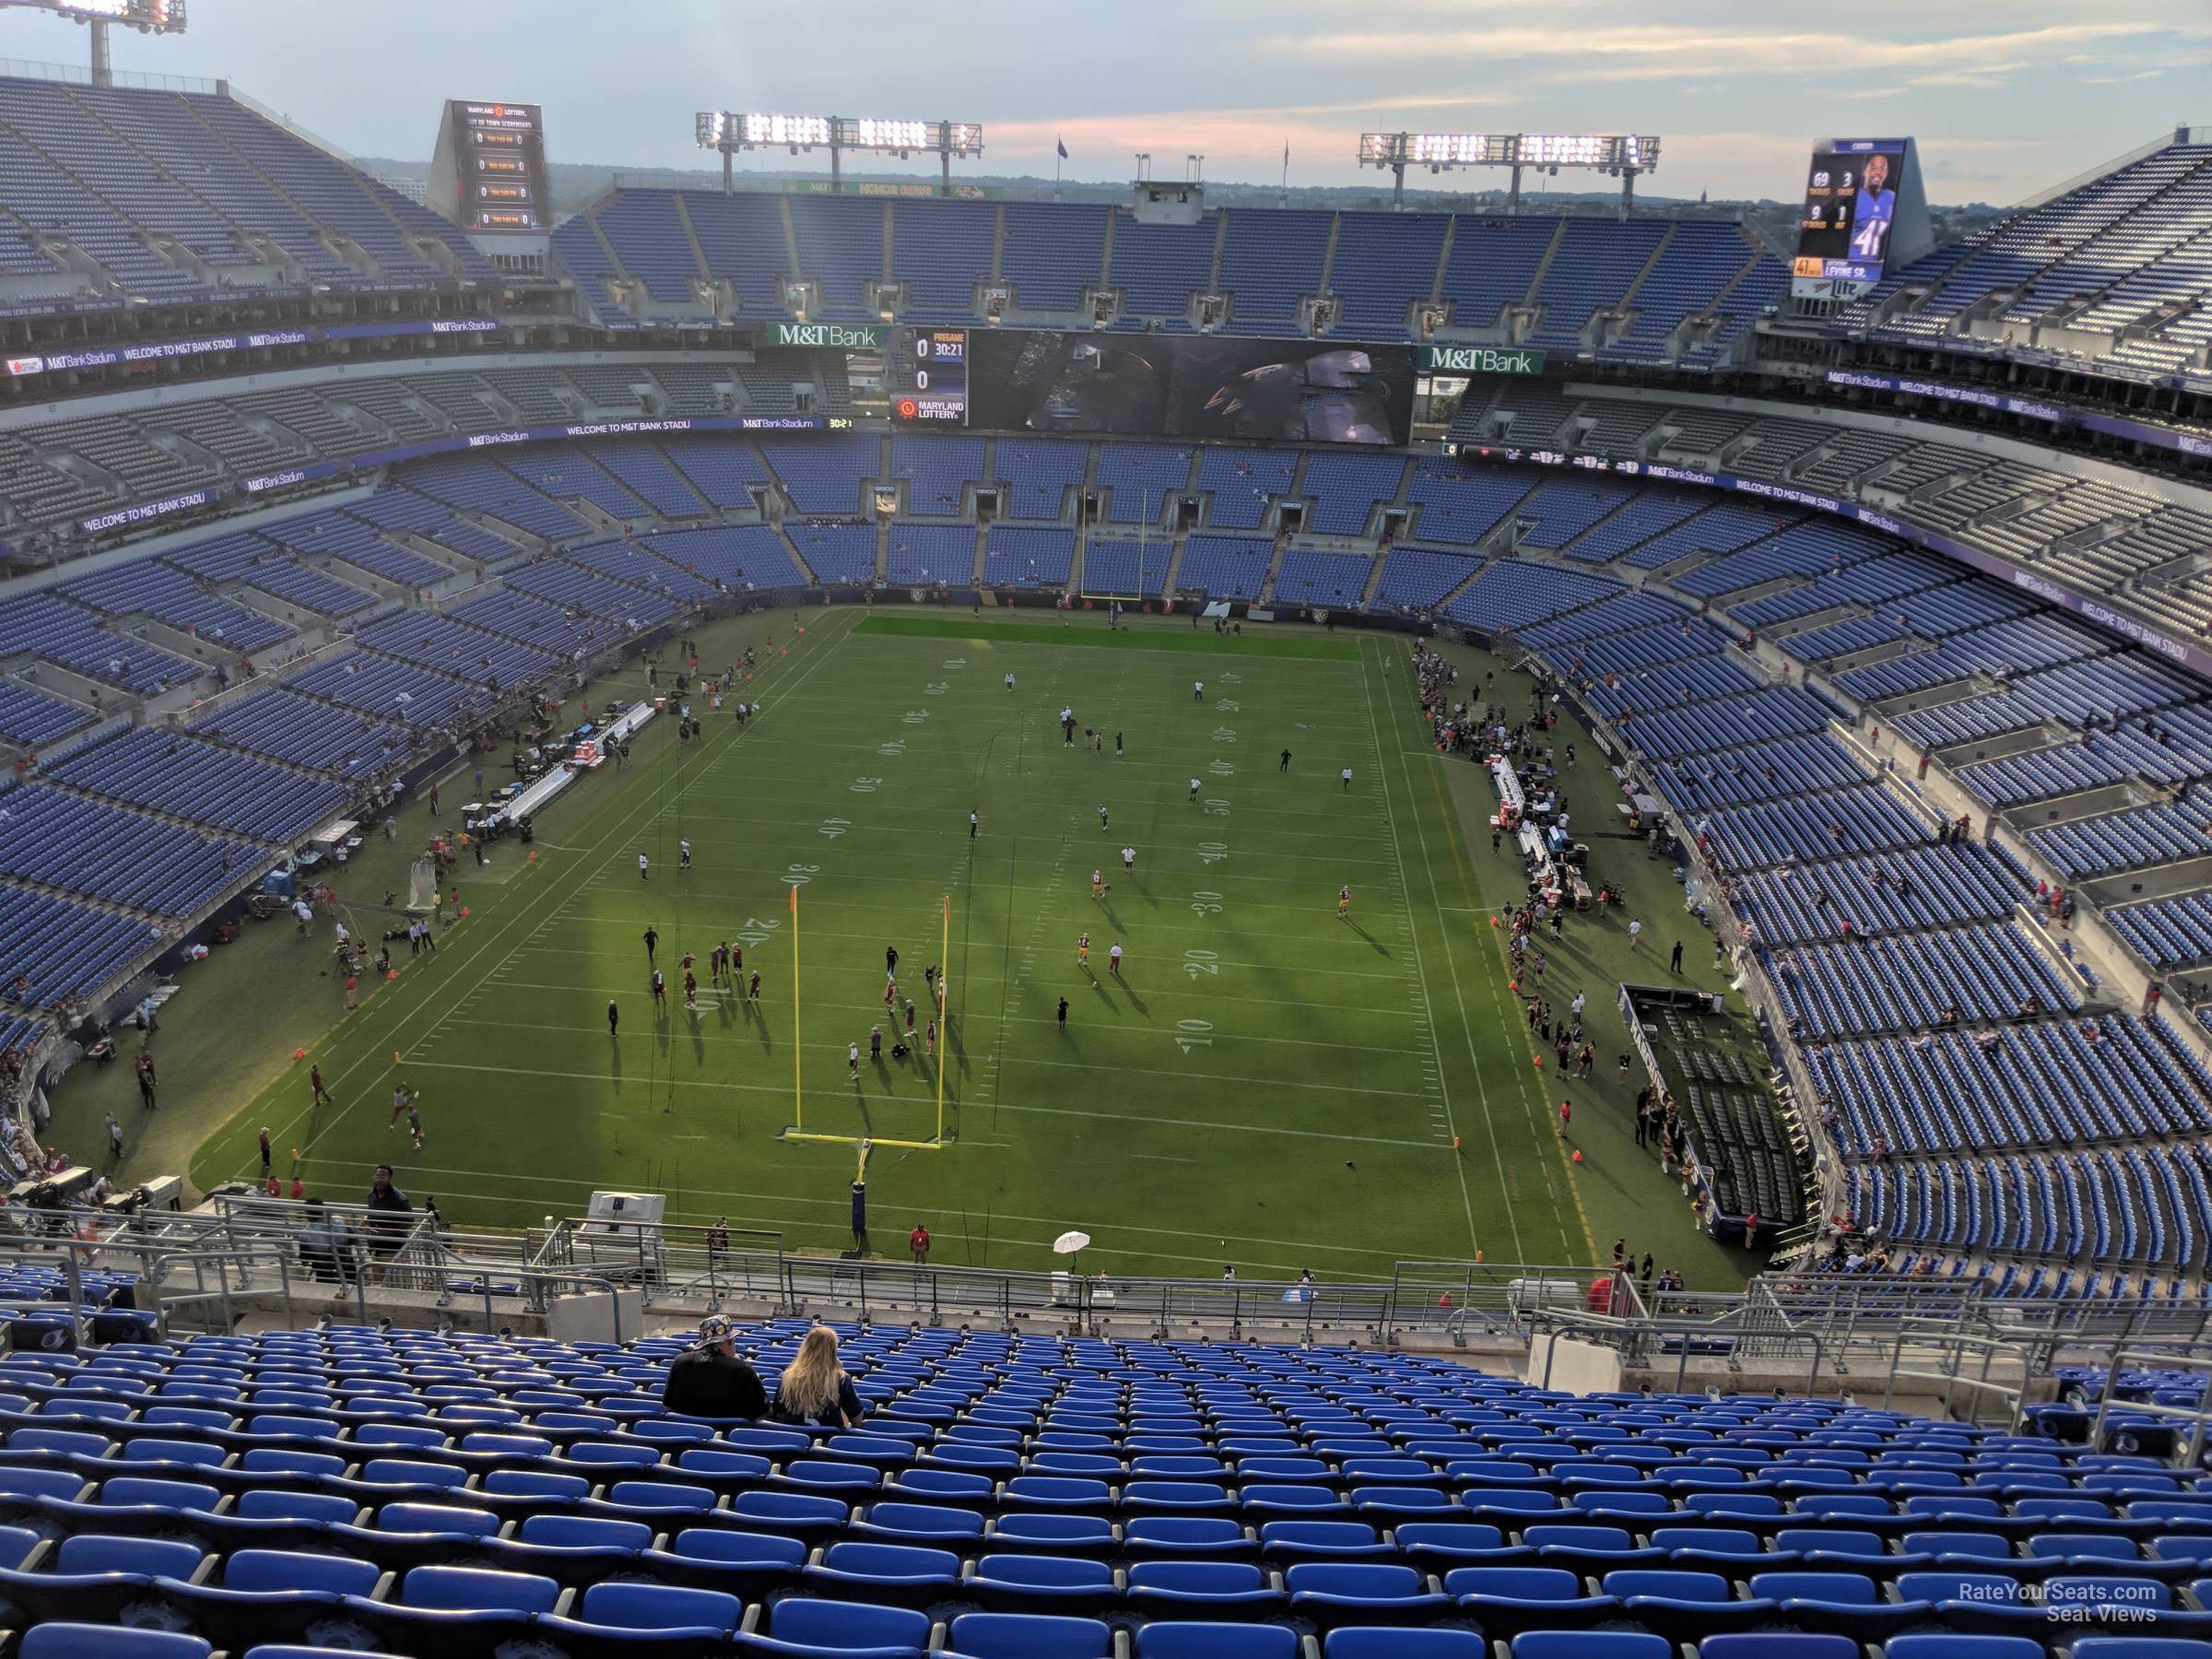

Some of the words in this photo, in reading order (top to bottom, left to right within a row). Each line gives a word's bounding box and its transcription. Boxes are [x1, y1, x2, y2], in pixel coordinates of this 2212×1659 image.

[477, 133, 482, 143] 0
[517, 135, 522, 144] 0
[480, 160, 484, 170] 0
[519, 162, 524, 171] 0
[1843, 172, 1853, 187] 3
[482, 187, 487, 196] 0
[521, 188, 526, 197] 0
[483, 214, 488, 224] 0
[523, 215, 528, 224] 0
[1839, 206, 1846, 221] 1
[1853, 220, 1888, 255] 41
[1825, 267, 1853, 277] LEVINE
[1830, 280, 1856, 298] Lite
[433, 322, 451, 332] M&T
[452, 321, 468, 331] Bank
[468, 321, 495, 330] Stadium
[779, 324, 829, 345] M&T
[830, 326, 877, 347] Bank
[250, 335, 265, 347] M&T
[265, 334, 280, 345] Bank
[281, 333, 305, 343] Stadium
[934, 333, 965, 342] PREGAME
[124, 346, 163, 360] WELCOME
[163, 345, 175, 355] TO
[192, 342, 212, 353] BANK
[918, 339, 928, 358] 0
[935, 343, 962, 357] 30:21
[47, 357, 67, 369] M&T
[67, 354, 87, 368] Bank
[87, 351, 117, 365] Stadium
[1430, 347, 1483, 369] M&T
[1483, 350, 1532, 372] Bank
[918, 371, 928, 390] 0
[919, 401, 964, 412] MARYLAND
[568, 424, 607, 435] WELCOME
[609, 424, 620, 432] TO
[621, 423, 638, 431] M&T
[640, 421, 661, 430] BANK
[743, 419, 763, 428] M&T
[763, 419, 782, 428] Bank
[782, 419, 813, 428] Stadium
[830, 418, 852, 428] 30:21
[470, 436, 485, 447] M&T
[486, 434, 500, 444] Bank
[500, 431, 529, 442] Stadium
[248, 478, 265, 491] M&T
[265, 475, 279, 488] Bank
[279, 471, 305, 485] Stadium
[1648, 465, 1668, 476] M&T
[1668, 467, 1686, 479] Bank
[1686, 470, 1714, 484] Stadium
[1736, 479, 1772, 495] WELCOME
[1773, 487, 1783, 497] TO
[1800, 493, 1818, 505] BANK
[84, 512, 127, 531] WELCOME
[128, 509, 139, 521] TO
[141, 504, 157, 518] M&T
[159, 499, 180, 514] BANK
[2082, 601, 2115, 625] WELCOME
[2115, 616, 2127, 630] TO
[2142, 628, 2163, 648] BANK
[902, 708, 930, 724] 30
[1213, 729, 1236, 742] 30
[877, 739, 907, 756] 40
[1209, 762, 1234, 776] 40
[849, 776, 883, 793] 50
[1203, 799, 1231, 817] 50
[818, 817, 853, 835] 40
[1197, 842, 1228, 860] 40
[780, 862, 820, 884] 30
[1191, 891, 1224, 913] 30
[736, 918, 781, 943] 20
[1182, 949, 1219, 975] 20
[683, 988, 731, 1011] 10
[1175, 1018, 1214, 1047] 10
